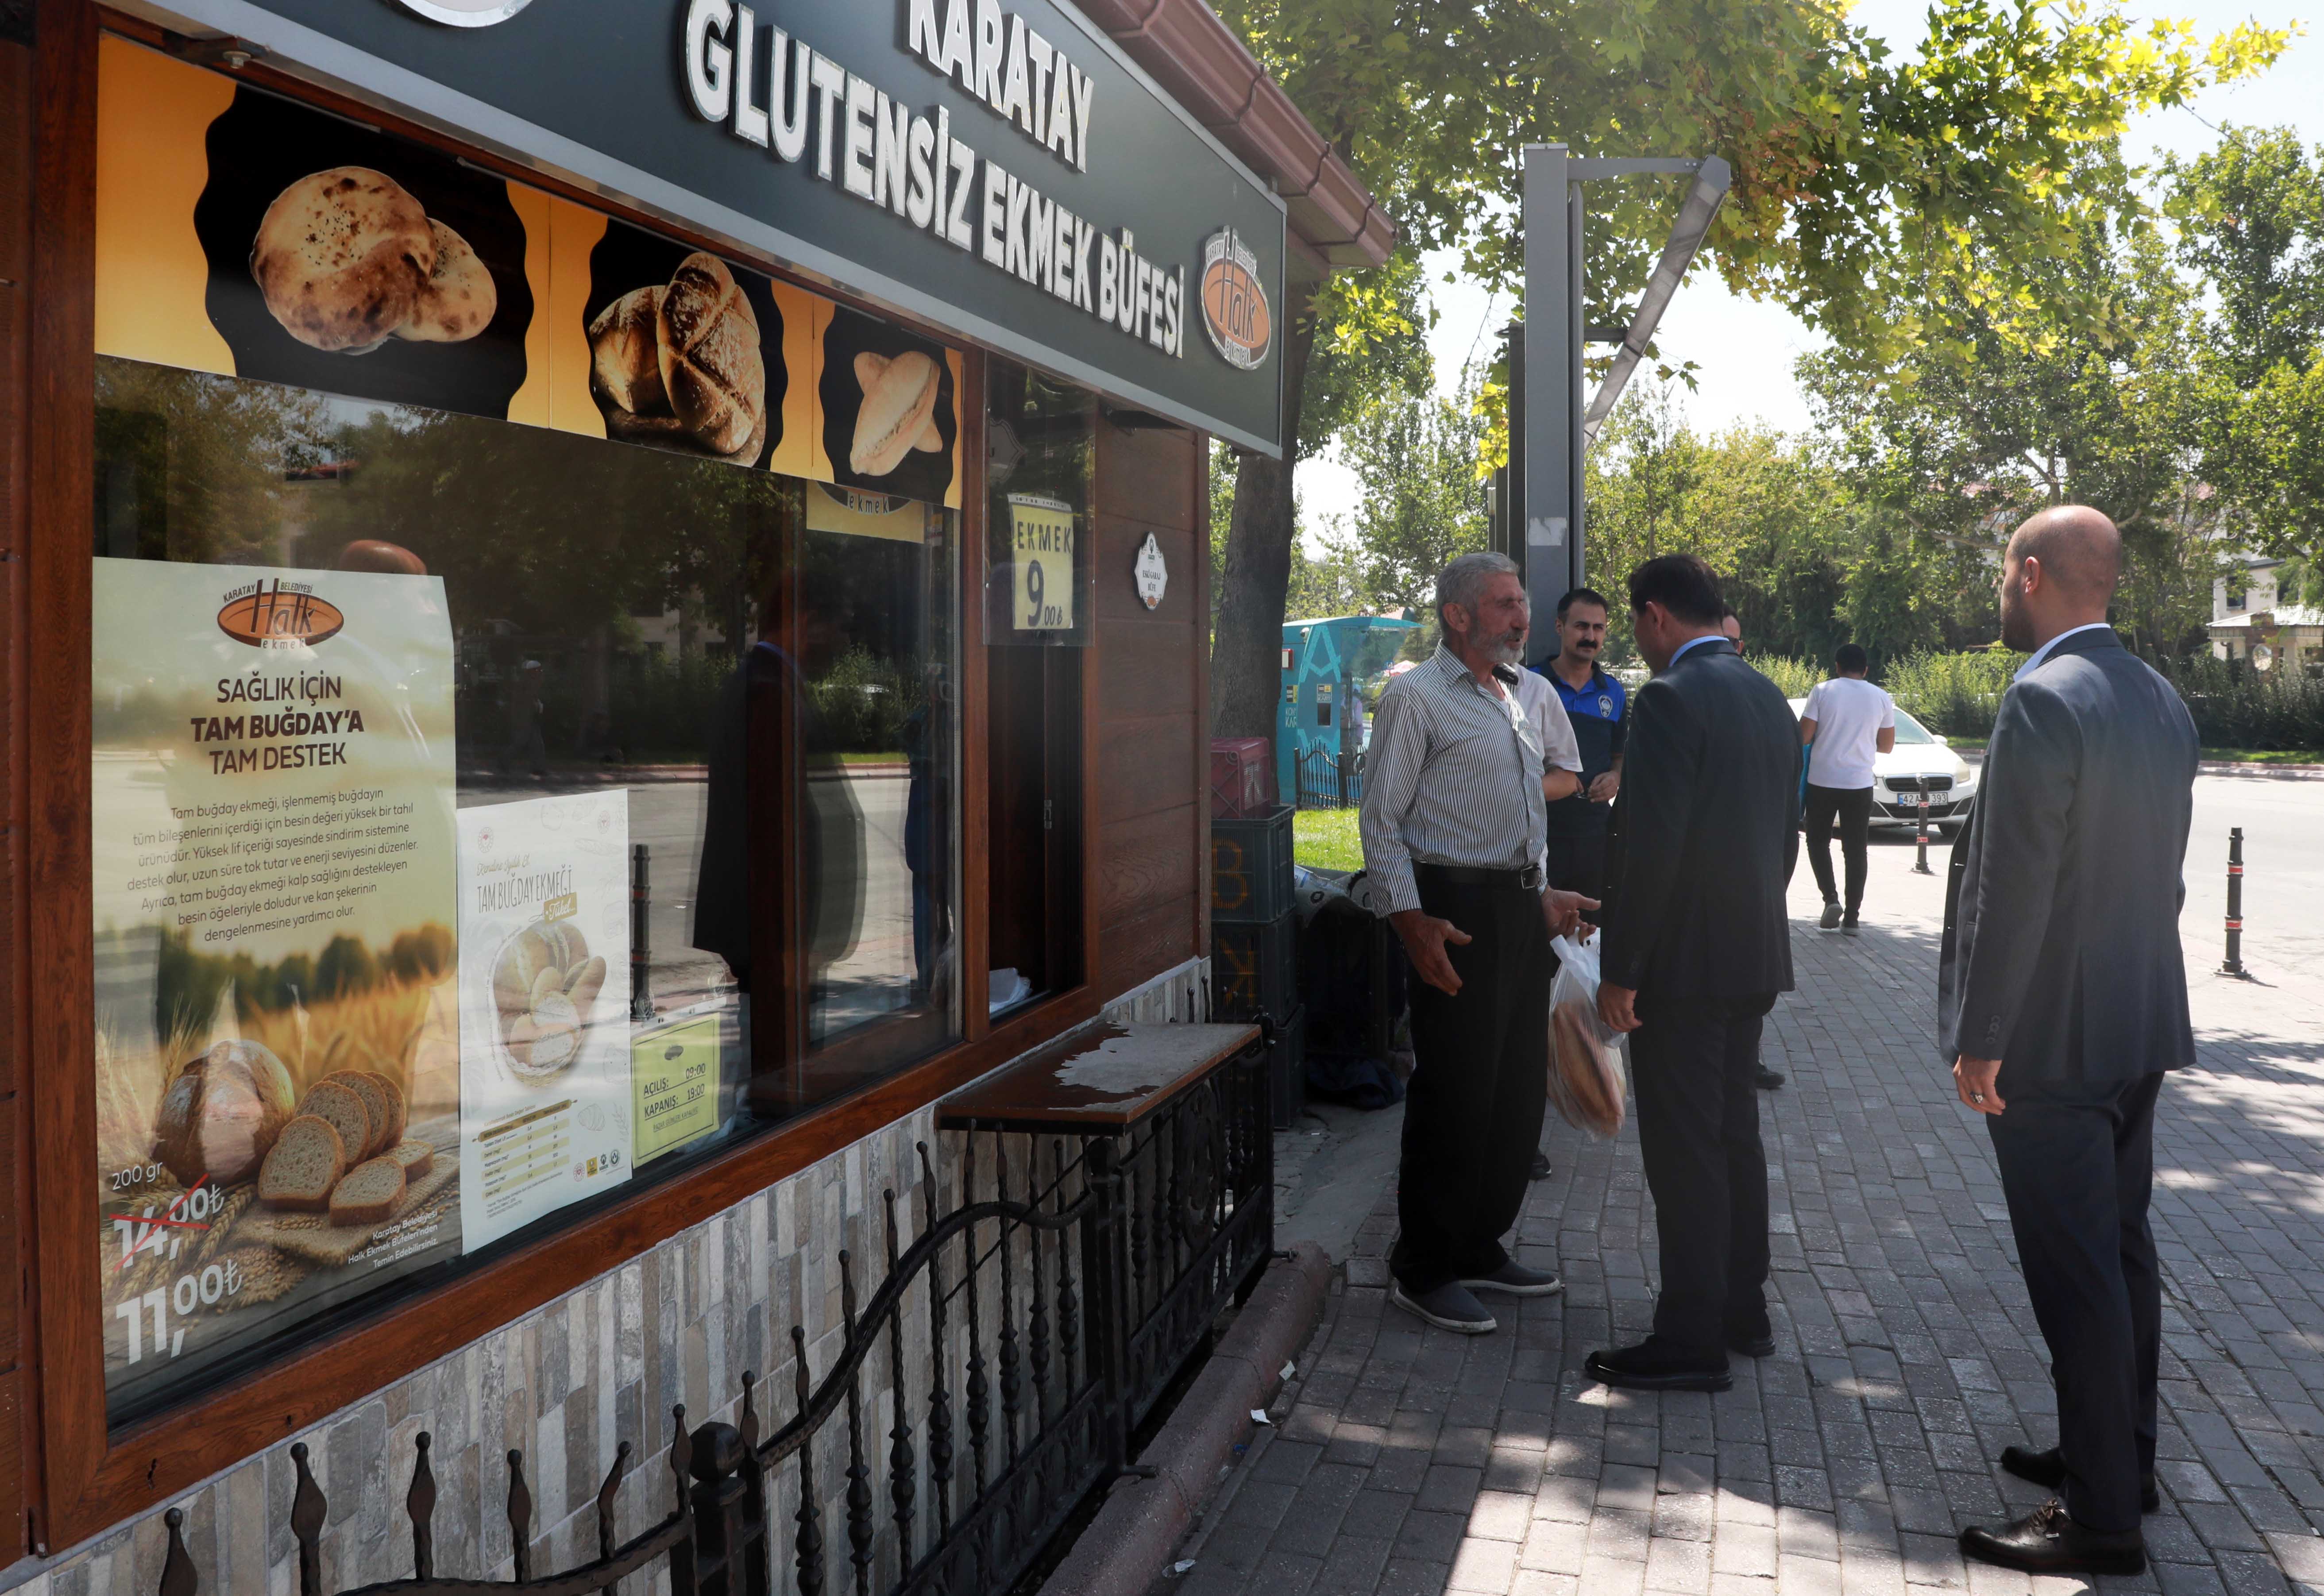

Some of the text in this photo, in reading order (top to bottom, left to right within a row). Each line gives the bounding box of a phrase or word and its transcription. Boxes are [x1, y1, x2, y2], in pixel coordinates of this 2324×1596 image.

[683, 0, 1185, 359] GLUTENSİZ EKMEK BÜFESİ
[1219, 232, 1257, 343] Halk
[1226, 339, 1251, 365] ekmek
[850, 493, 888, 513] ekmek
[1017, 520, 1071, 553] EKMEK
[223, 582, 313, 603] KARATAY BELEDİYESİ
[250, 578, 317, 636] Halk
[263, 638, 305, 649] ekmek
[217, 670, 341, 706] SAĞLIK İÇİN
[191, 706, 364, 742] TAM BUĞDAY'A
[209, 742, 347, 775] TAM DESTEK
[171, 788, 383, 819] Tam buğday ekmeği, işlenmemiş buğdayın
[1904, 794, 1913, 803] 42
[1932, 794, 1946, 802] 393
[133, 802, 413, 845] tüm bileşenlerini içerdiği için besin değeri yüksek bir tahıl
[139, 822, 409, 867] ürünüdür. Yüksek lif içeriği sayesinde sindirim sistemine
[127, 840, 418, 891] destek olur, uzun süre tok tutar ve enerji seviyesini düzenler.
[142, 860, 407, 912] Ayrıca, tam buğday ekmeği kalp sağlığını destekleyen
[477, 864, 573, 914] TAM BUĞDAY EKMEĞİ
[178, 882, 376, 925] besin öğeleriyle doludur ve kan şekerinin
[205, 906, 354, 942] dengelenmesine yardımcı olur.
[644, 1063, 706, 1095] AÇILIŞ: 09:00
[645, 1083, 705, 1118] KAPANIŞ: 19:00
[112, 1162, 163, 1191] 200 gr
[373, 1209, 437, 1240] Karatay Belediyesi
[348, 1252, 365, 1264] Halk
[367, 1241, 390, 1257] Ekmek
[373, 1254, 394, 1268] Temin
